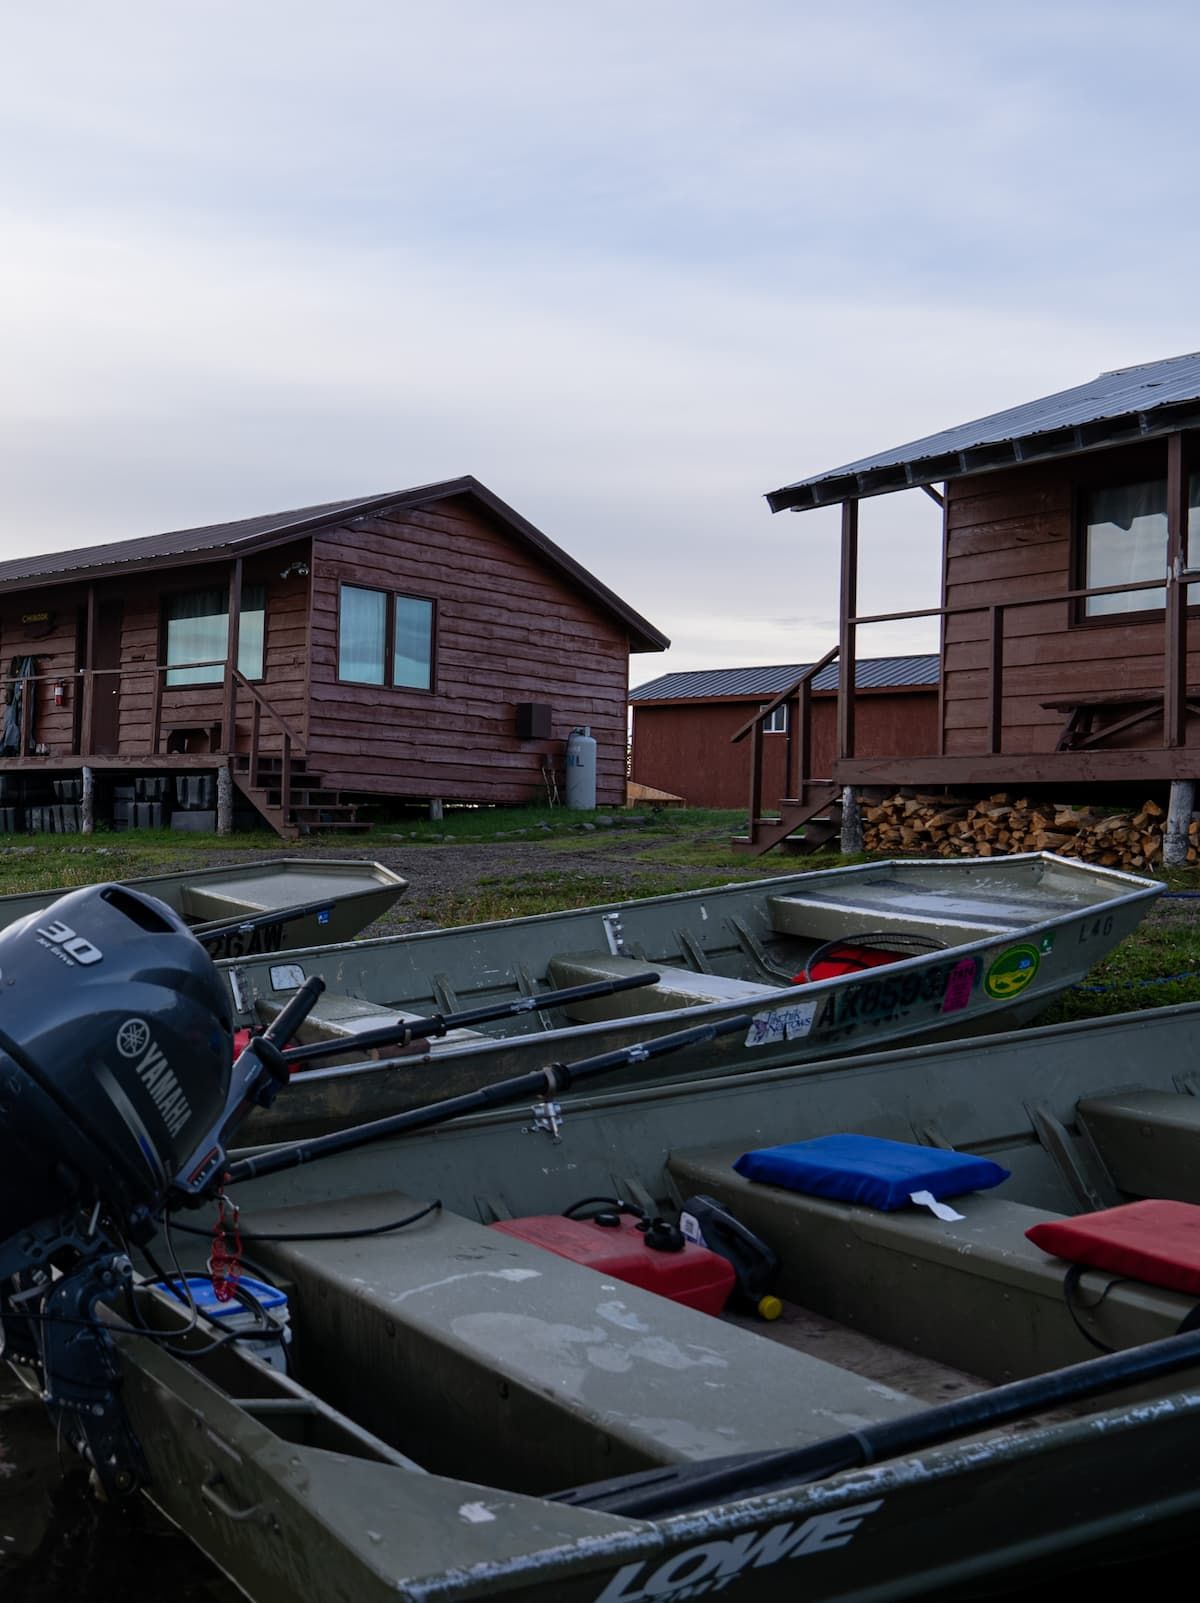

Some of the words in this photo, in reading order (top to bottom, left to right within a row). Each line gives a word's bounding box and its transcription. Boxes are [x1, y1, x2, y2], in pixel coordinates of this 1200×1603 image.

[36, 920, 103, 966] 30
[135, 1041, 193, 1139] YAMAHA
[595, 1499, 885, 1603] LOWE
